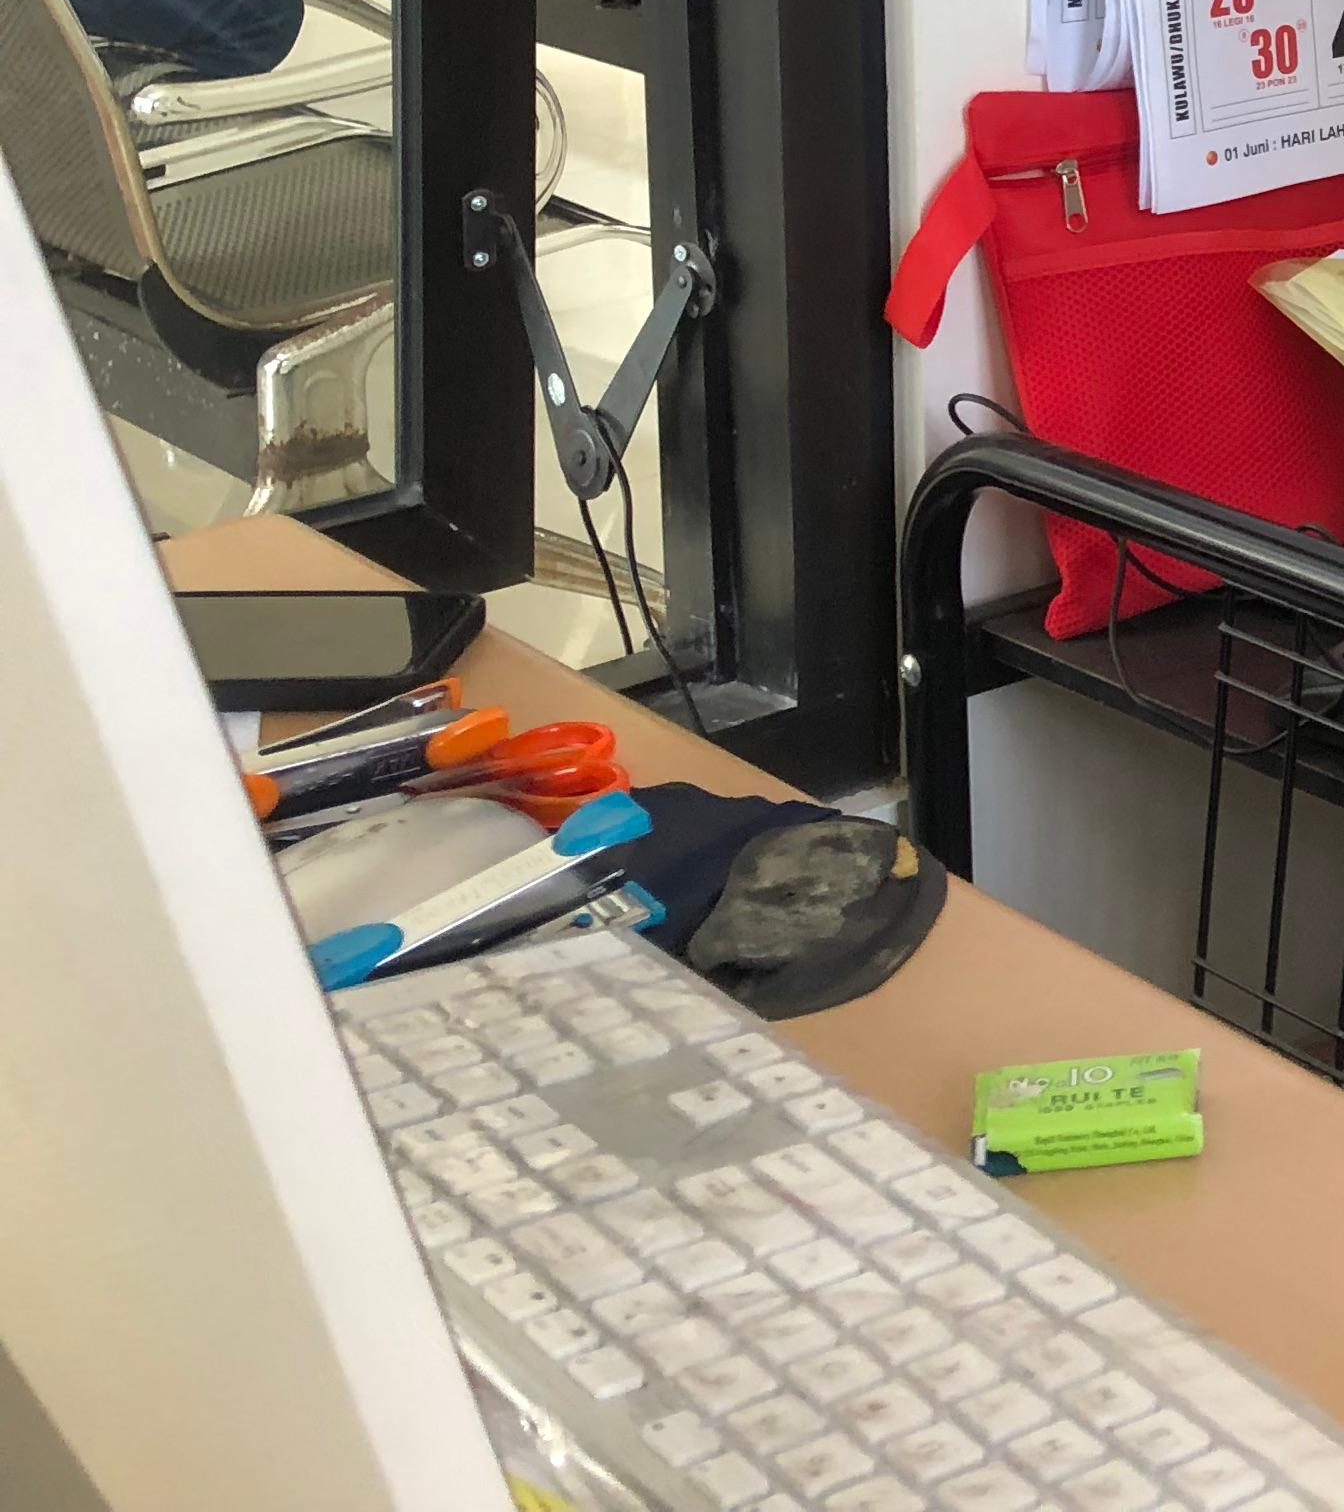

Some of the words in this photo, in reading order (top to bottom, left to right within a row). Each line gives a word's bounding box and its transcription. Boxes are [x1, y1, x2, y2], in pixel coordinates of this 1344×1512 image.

[1249, 24, 1299, 80] 30
[1224, 147, 1239, 162] 01
[1242, 140, 1270, 159] Juni
[1280, 128, 1316, 150] HARI
